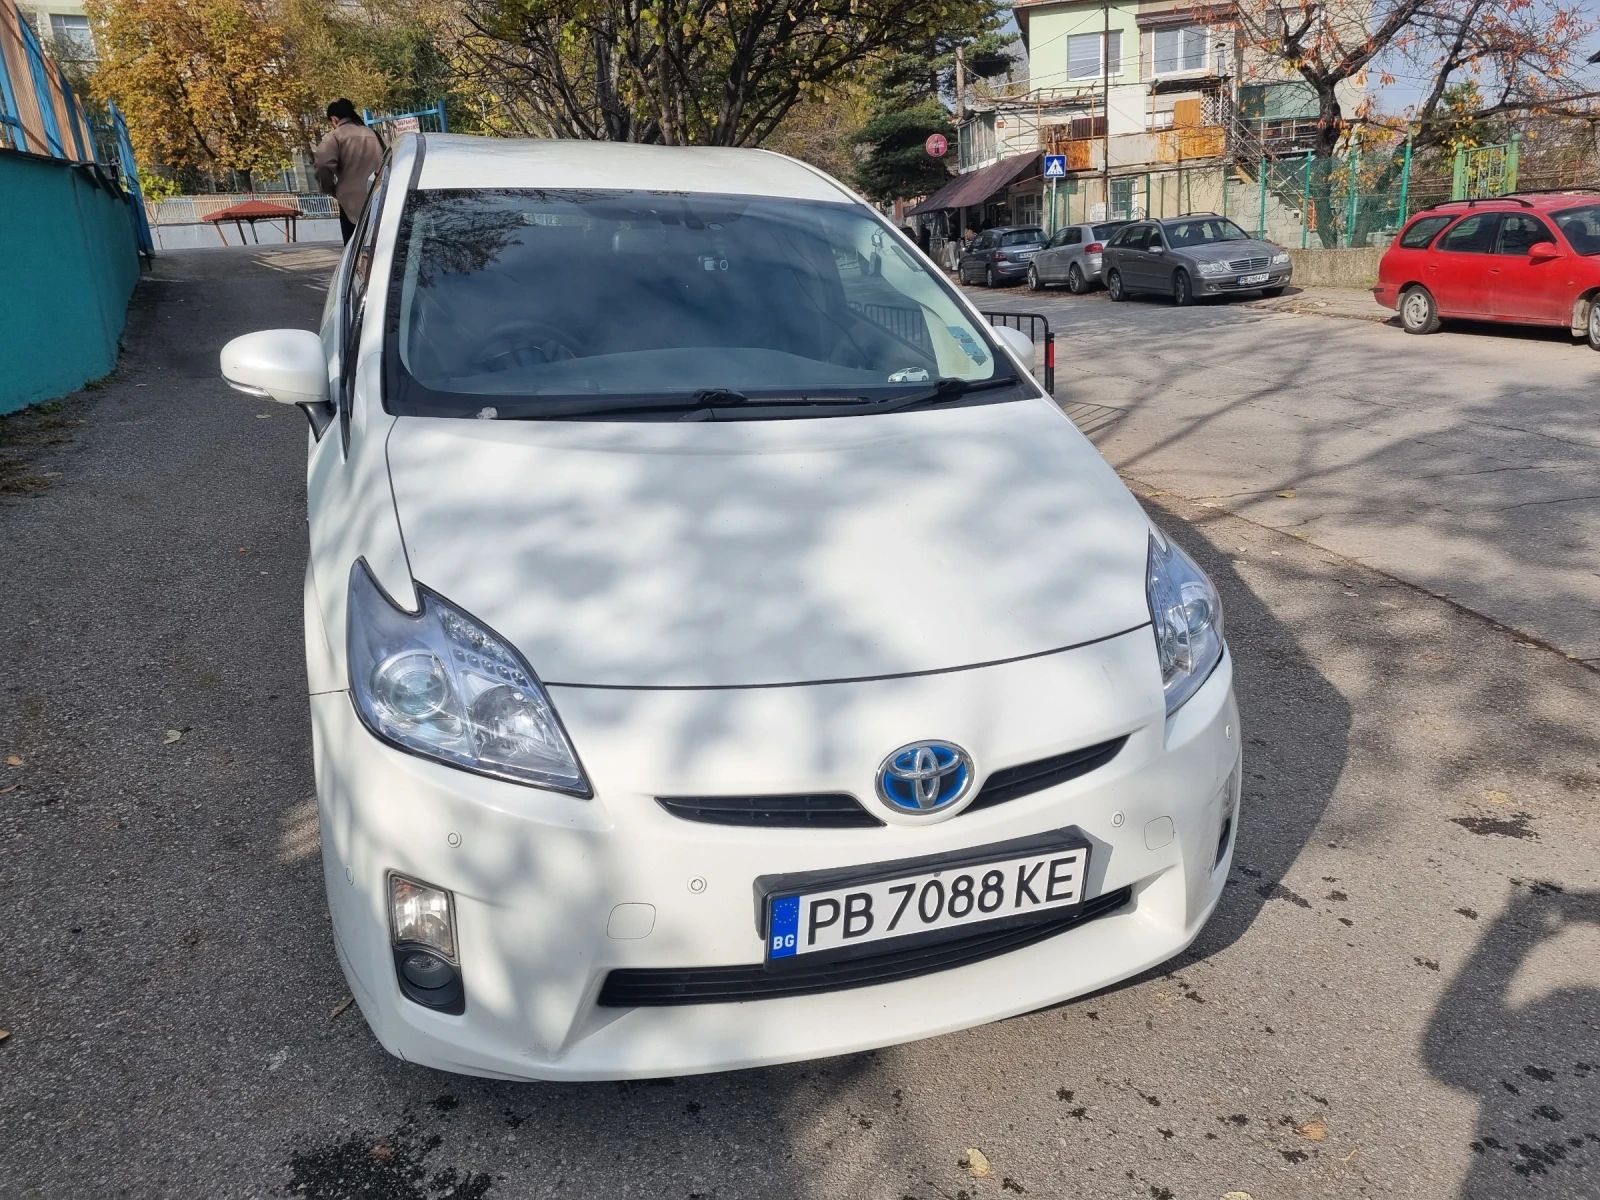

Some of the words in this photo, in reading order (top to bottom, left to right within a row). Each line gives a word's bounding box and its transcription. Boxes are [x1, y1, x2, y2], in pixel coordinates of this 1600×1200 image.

[807, 892, 874, 946] PB
[886, 869, 1005, 932] 7088
[1014, 855, 1078, 909] KE
[773, 934, 795, 950] BG
